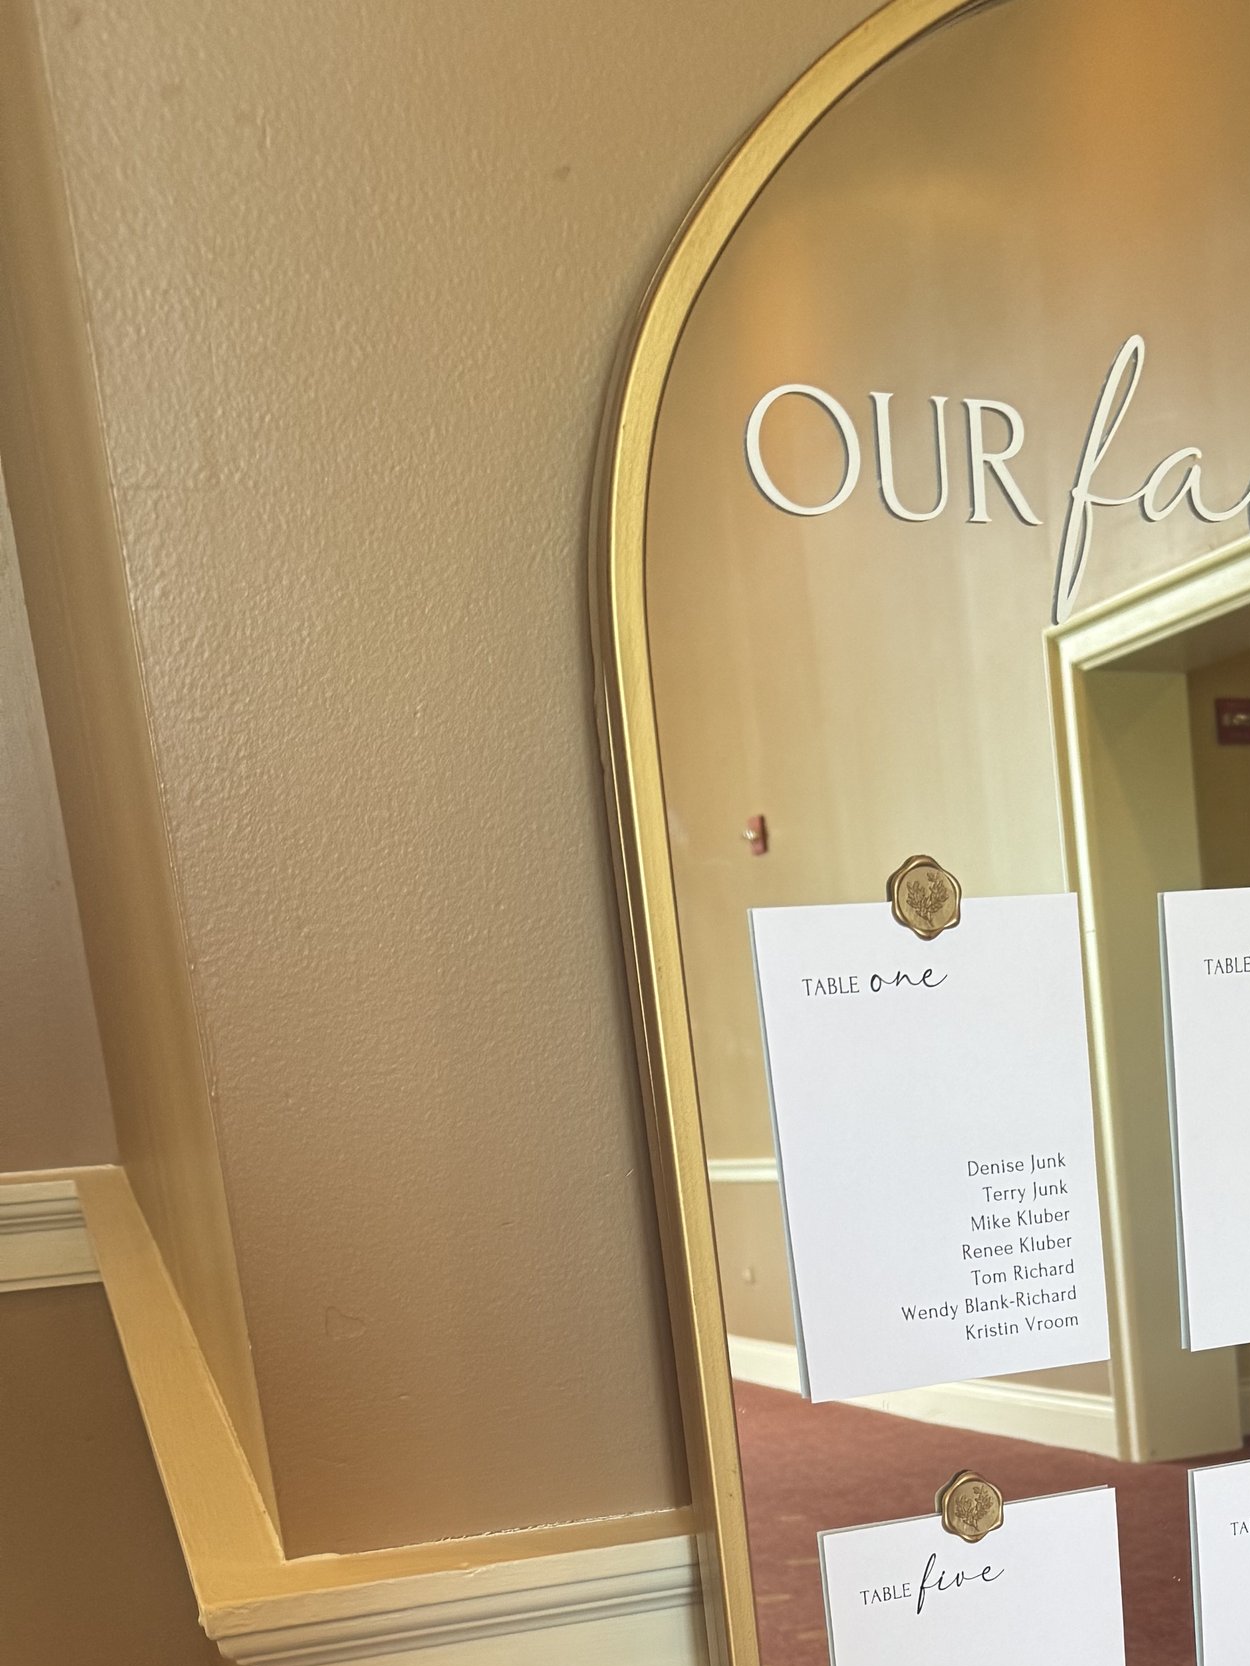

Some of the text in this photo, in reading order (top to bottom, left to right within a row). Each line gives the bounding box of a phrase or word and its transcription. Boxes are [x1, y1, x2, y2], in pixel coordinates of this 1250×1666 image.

[744, 383, 1043, 526] OUR
[802, 969, 948, 996] TABLE one
[968, 1152, 1066, 1176] Denise Junk
[971, 1208, 1070, 1231] Mike Kluber
[971, 1259, 1074, 1285] Tom Richard
[901, 1285, 1076, 1320] Wendy Blank-Richard
[966, 1316, 1078, 1340] Kristin Vroom
[860, 1553, 1004, 1615] TABLE five
